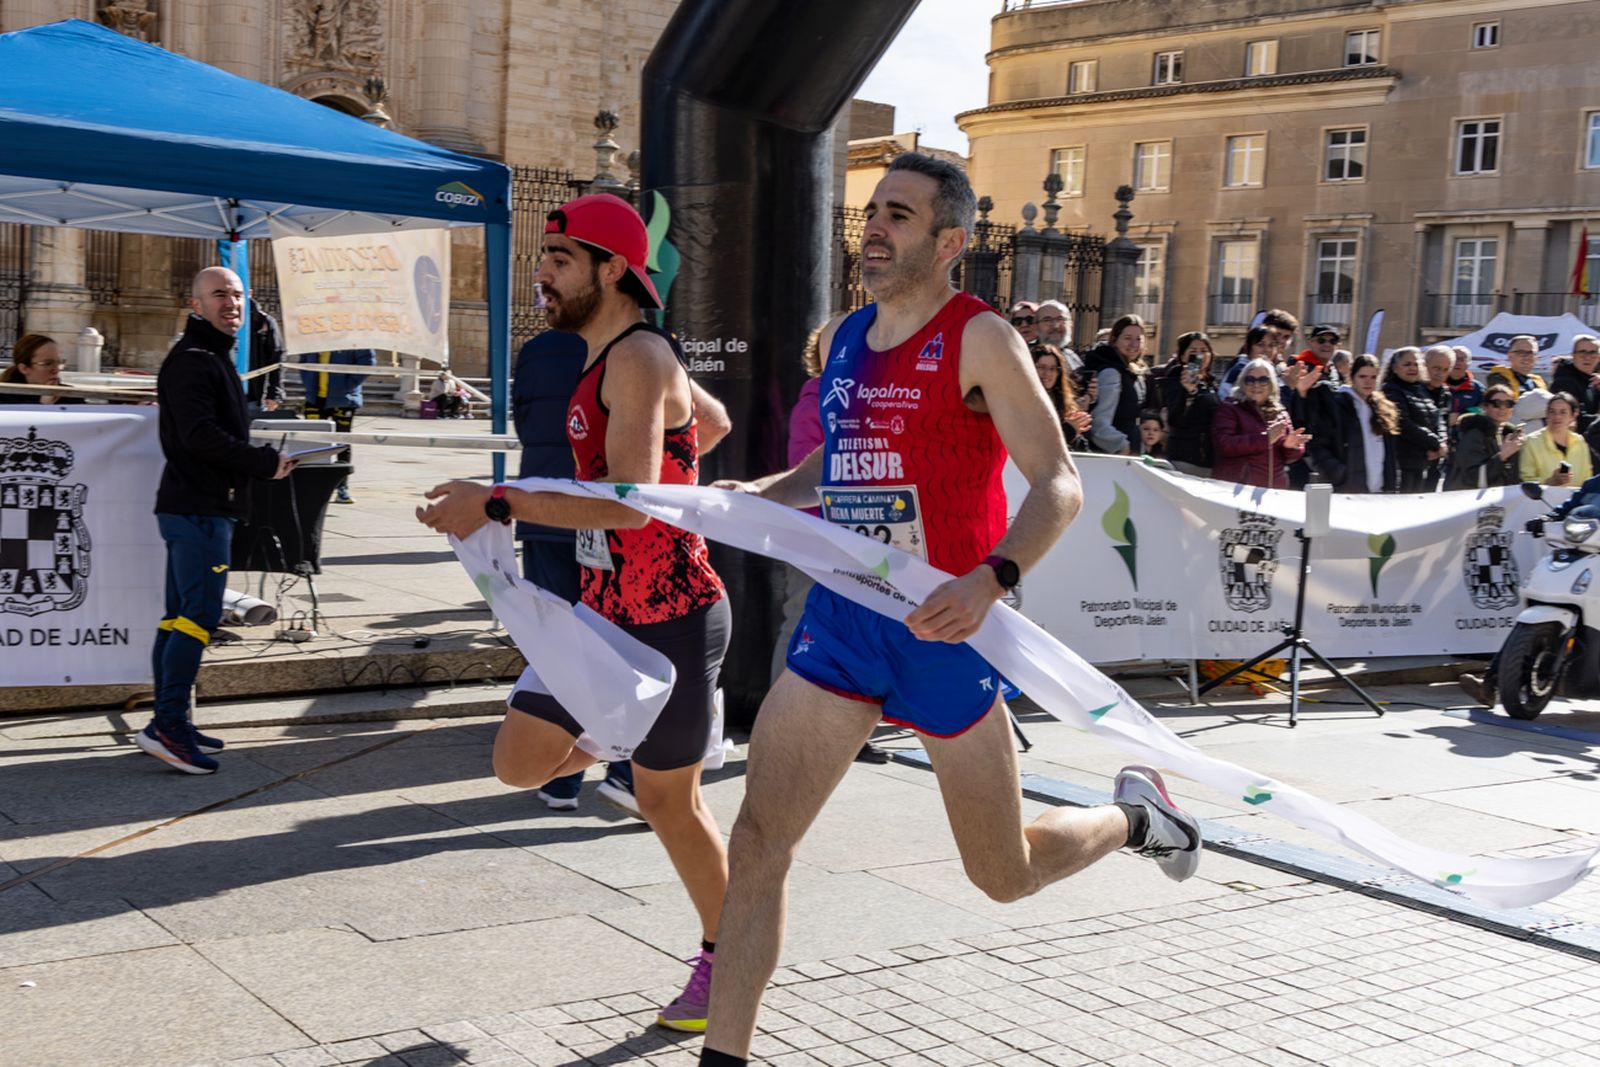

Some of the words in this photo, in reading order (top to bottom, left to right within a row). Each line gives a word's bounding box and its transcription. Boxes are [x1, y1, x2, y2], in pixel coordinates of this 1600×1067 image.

[435, 191, 479, 207] COBIZI
[725, 338, 748, 353] de
[688, 356, 725, 372] Jaén
[857, 383, 921, 404] lapalma
[871, 400, 918, 411] cooperativa
[830, 452, 904, 482] DELSUR
[851, 507, 885, 520] MUERTE
[1080, 600, 1131, 613] Patronato
[1166, 600, 1178, 612] de
[1327, 603, 1368, 613] Patronato
[1411, 603, 1422, 613] de
[1146, 614, 1168, 626] Jaén
[1208, 620, 1249, 632] CIUDAD
[1250, 621, 1265, 632] DE
[1339, 617, 1378, 628] Deportes
[1379, 617, 1390, 627] de
[1392, 616, 1412, 627] Jaén
[1455, 618, 1497, 630] CIUDAD
[1499, 617, 1514, 628] DE
[30, 628, 62, 646] DE
[68, 623, 129, 646] JAÉN
